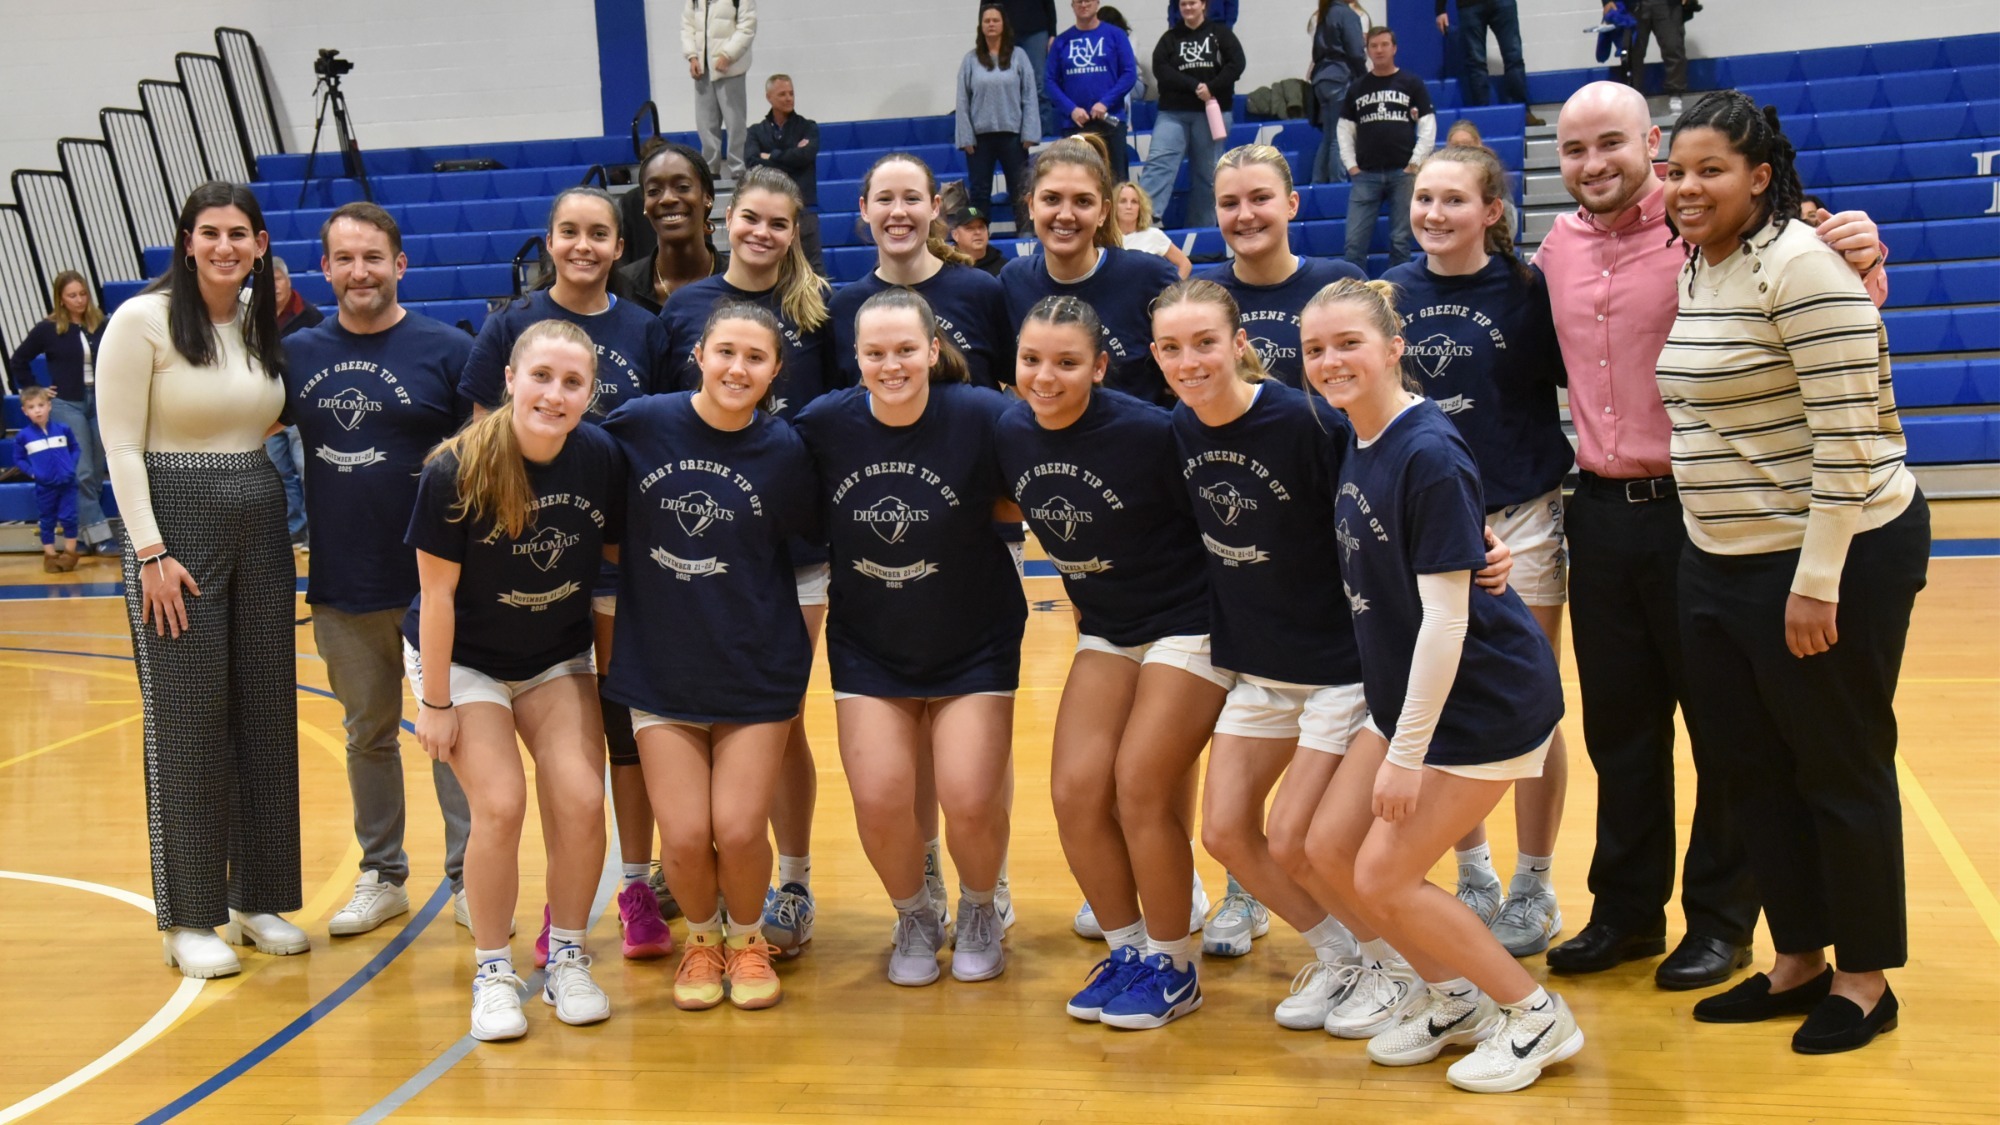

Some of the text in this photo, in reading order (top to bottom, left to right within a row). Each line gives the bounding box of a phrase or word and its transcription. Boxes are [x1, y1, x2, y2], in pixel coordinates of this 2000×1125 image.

[1066, 66, 1108, 75] BASKETBALL
[1178, 61, 1214, 71] BASKETBALL
[1355, 89, 1410, 111] FRANKLIN
[1240, 310, 1286, 323] REENE
[935, 315, 972, 350] TIP OFF
[1420, 304, 1507, 350] GREENE TIP OFF
[1109, 337, 1127, 357] OFF
[1403, 345, 1473, 357] DIPLOMATS
[609, 350, 640, 388] TIP OFF
[299, 360, 412, 405] TERRY GREENE TIP OFF
[317, 398, 382, 412] DIPLOMATS
[325, 450, 372, 463] NOVEMBER 21-22
[338, 465, 353, 473] 2025
[1203, 450, 1246, 466] GREENE
[1250, 459, 1270, 479] TIP
[1269, 479, 1291, 501] OFF
[639, 459, 763, 517] TERRY GREENE TIP OFF
[832, 461, 960, 507] TERRY GREENE TIP OFF
[1034, 462, 1079, 477] GREENE
[1082, 470, 1103, 489] TIP
[1102, 489, 1124, 511] OFF
[524, 493, 571, 513] GREENE
[574, 495, 591, 511] TIP
[660, 497, 735, 521] DIPLOMATS
[853, 509, 929, 522] DIPLOMATS
[1030, 507, 1093, 522] DIPLOMATS
[1357, 493, 1371, 515] TIP
[1369, 517, 1389, 542] OFF
[512, 533, 580, 555] DIPLOMATS
[660, 553, 713, 571] NOVEMBER 21-22
[866, 563, 923, 578] NOVEMBER 21-22
[675, 572, 692, 581] 2025
[513, 594, 548, 603] NOVEMBER
